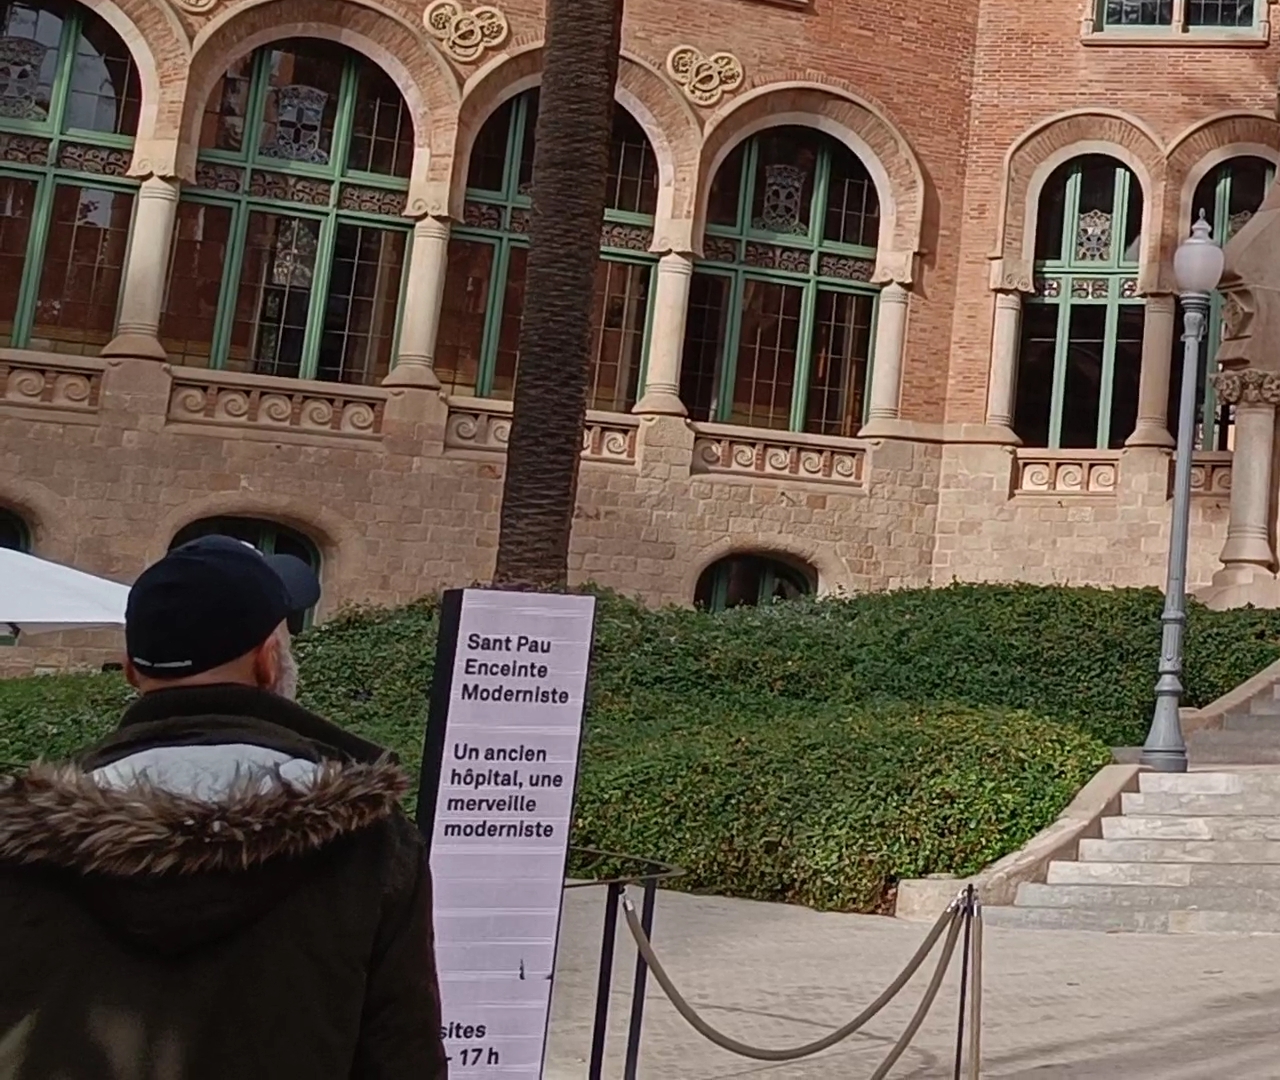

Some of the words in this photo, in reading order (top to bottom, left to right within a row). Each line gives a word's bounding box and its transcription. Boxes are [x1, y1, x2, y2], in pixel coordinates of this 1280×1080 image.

[467, 633, 512, 652] Sant
[516, 635, 552, 654] Pau
[464, 658, 548, 678] Enceinte
[461, 683, 569, 704] Moderniste
[454, 743, 479, 760] Un
[484, 744, 547, 762] ancien
[450, 768, 524, 789] hôpital,
[529, 773, 563, 787] une
[447, 795, 537, 812] merveille
[444, 820, 554, 837] moderniste
[439, 1021, 487, 1040] sites
[460, 1048, 483, 1066] 17
[487, 1047, 499, 1065] h
